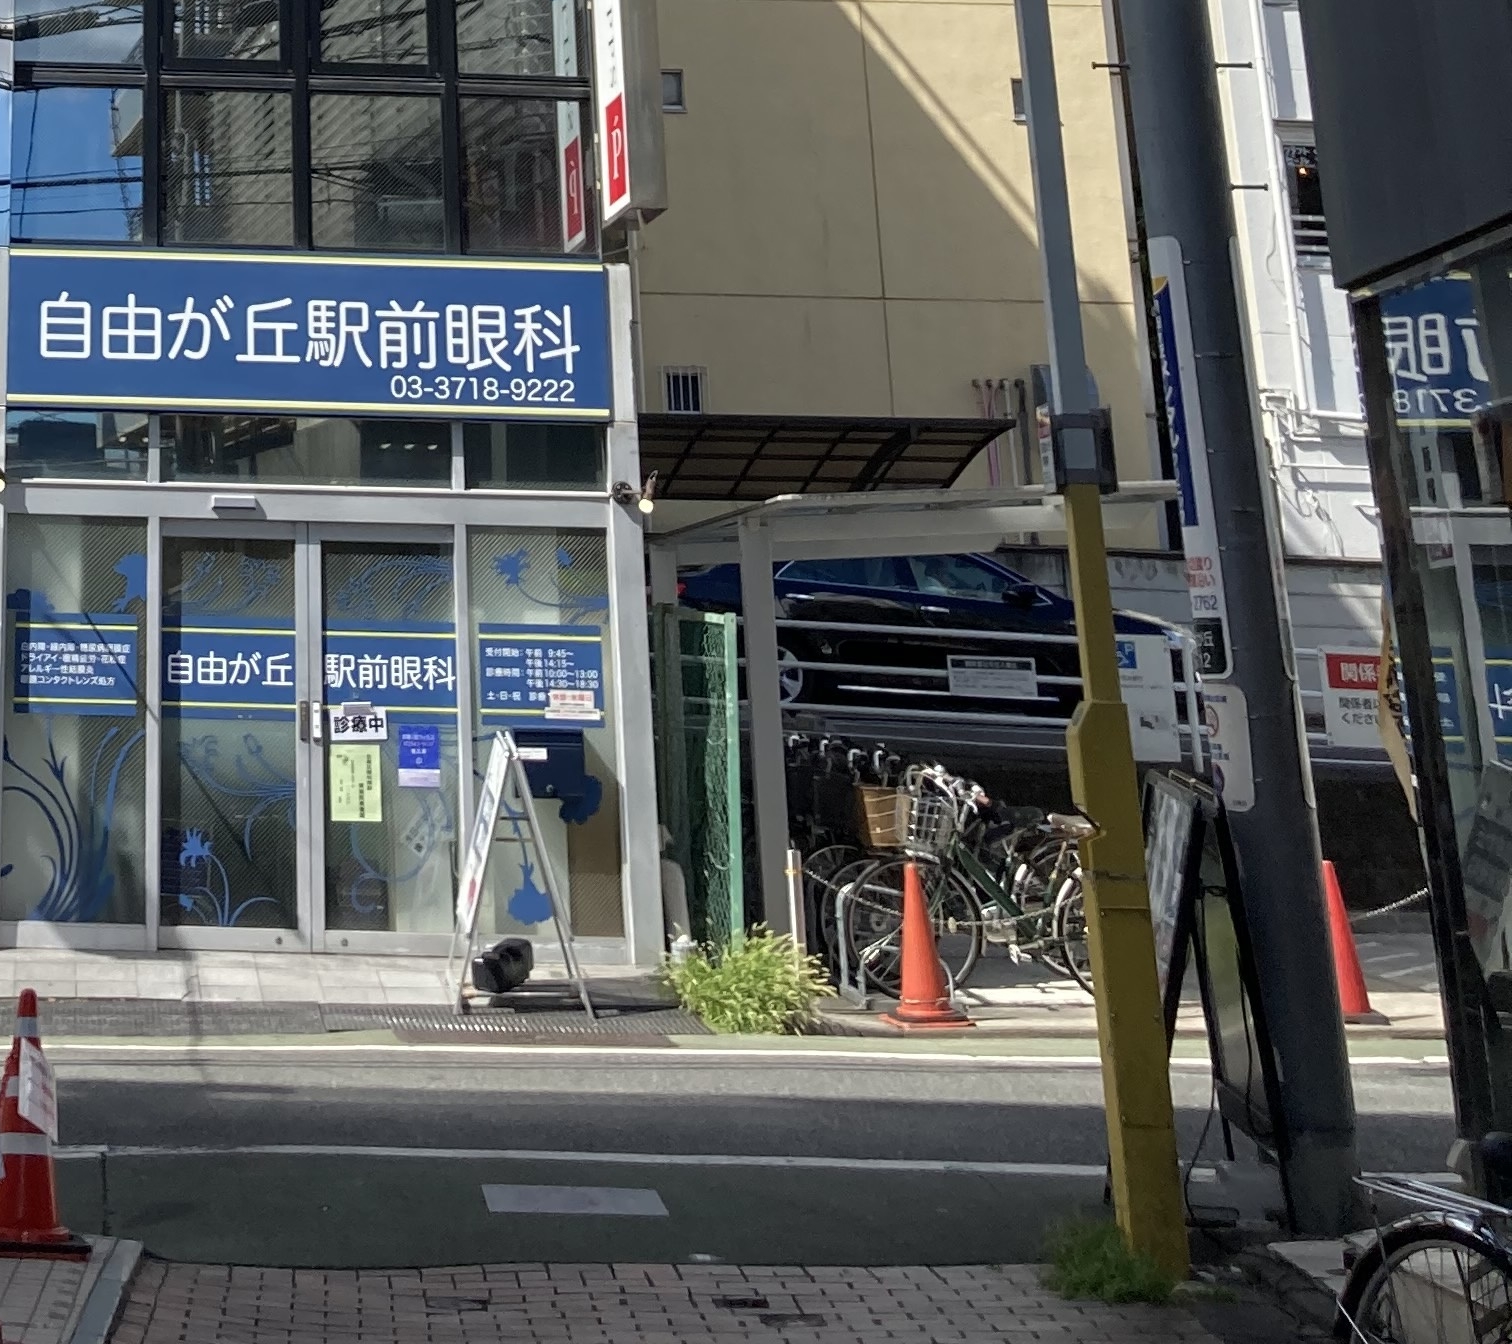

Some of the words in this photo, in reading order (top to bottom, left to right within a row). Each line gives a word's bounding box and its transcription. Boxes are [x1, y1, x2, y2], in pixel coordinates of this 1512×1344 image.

[39, 290, 581, 374] 自由が丘駅前眼科
[390, 374, 576, 404] 03-3718-9222
[167, 649, 294, 686] 自由が丘
[324, 653, 457, 691] 駅前眼科
[333, 715, 384, 734] 診療中
